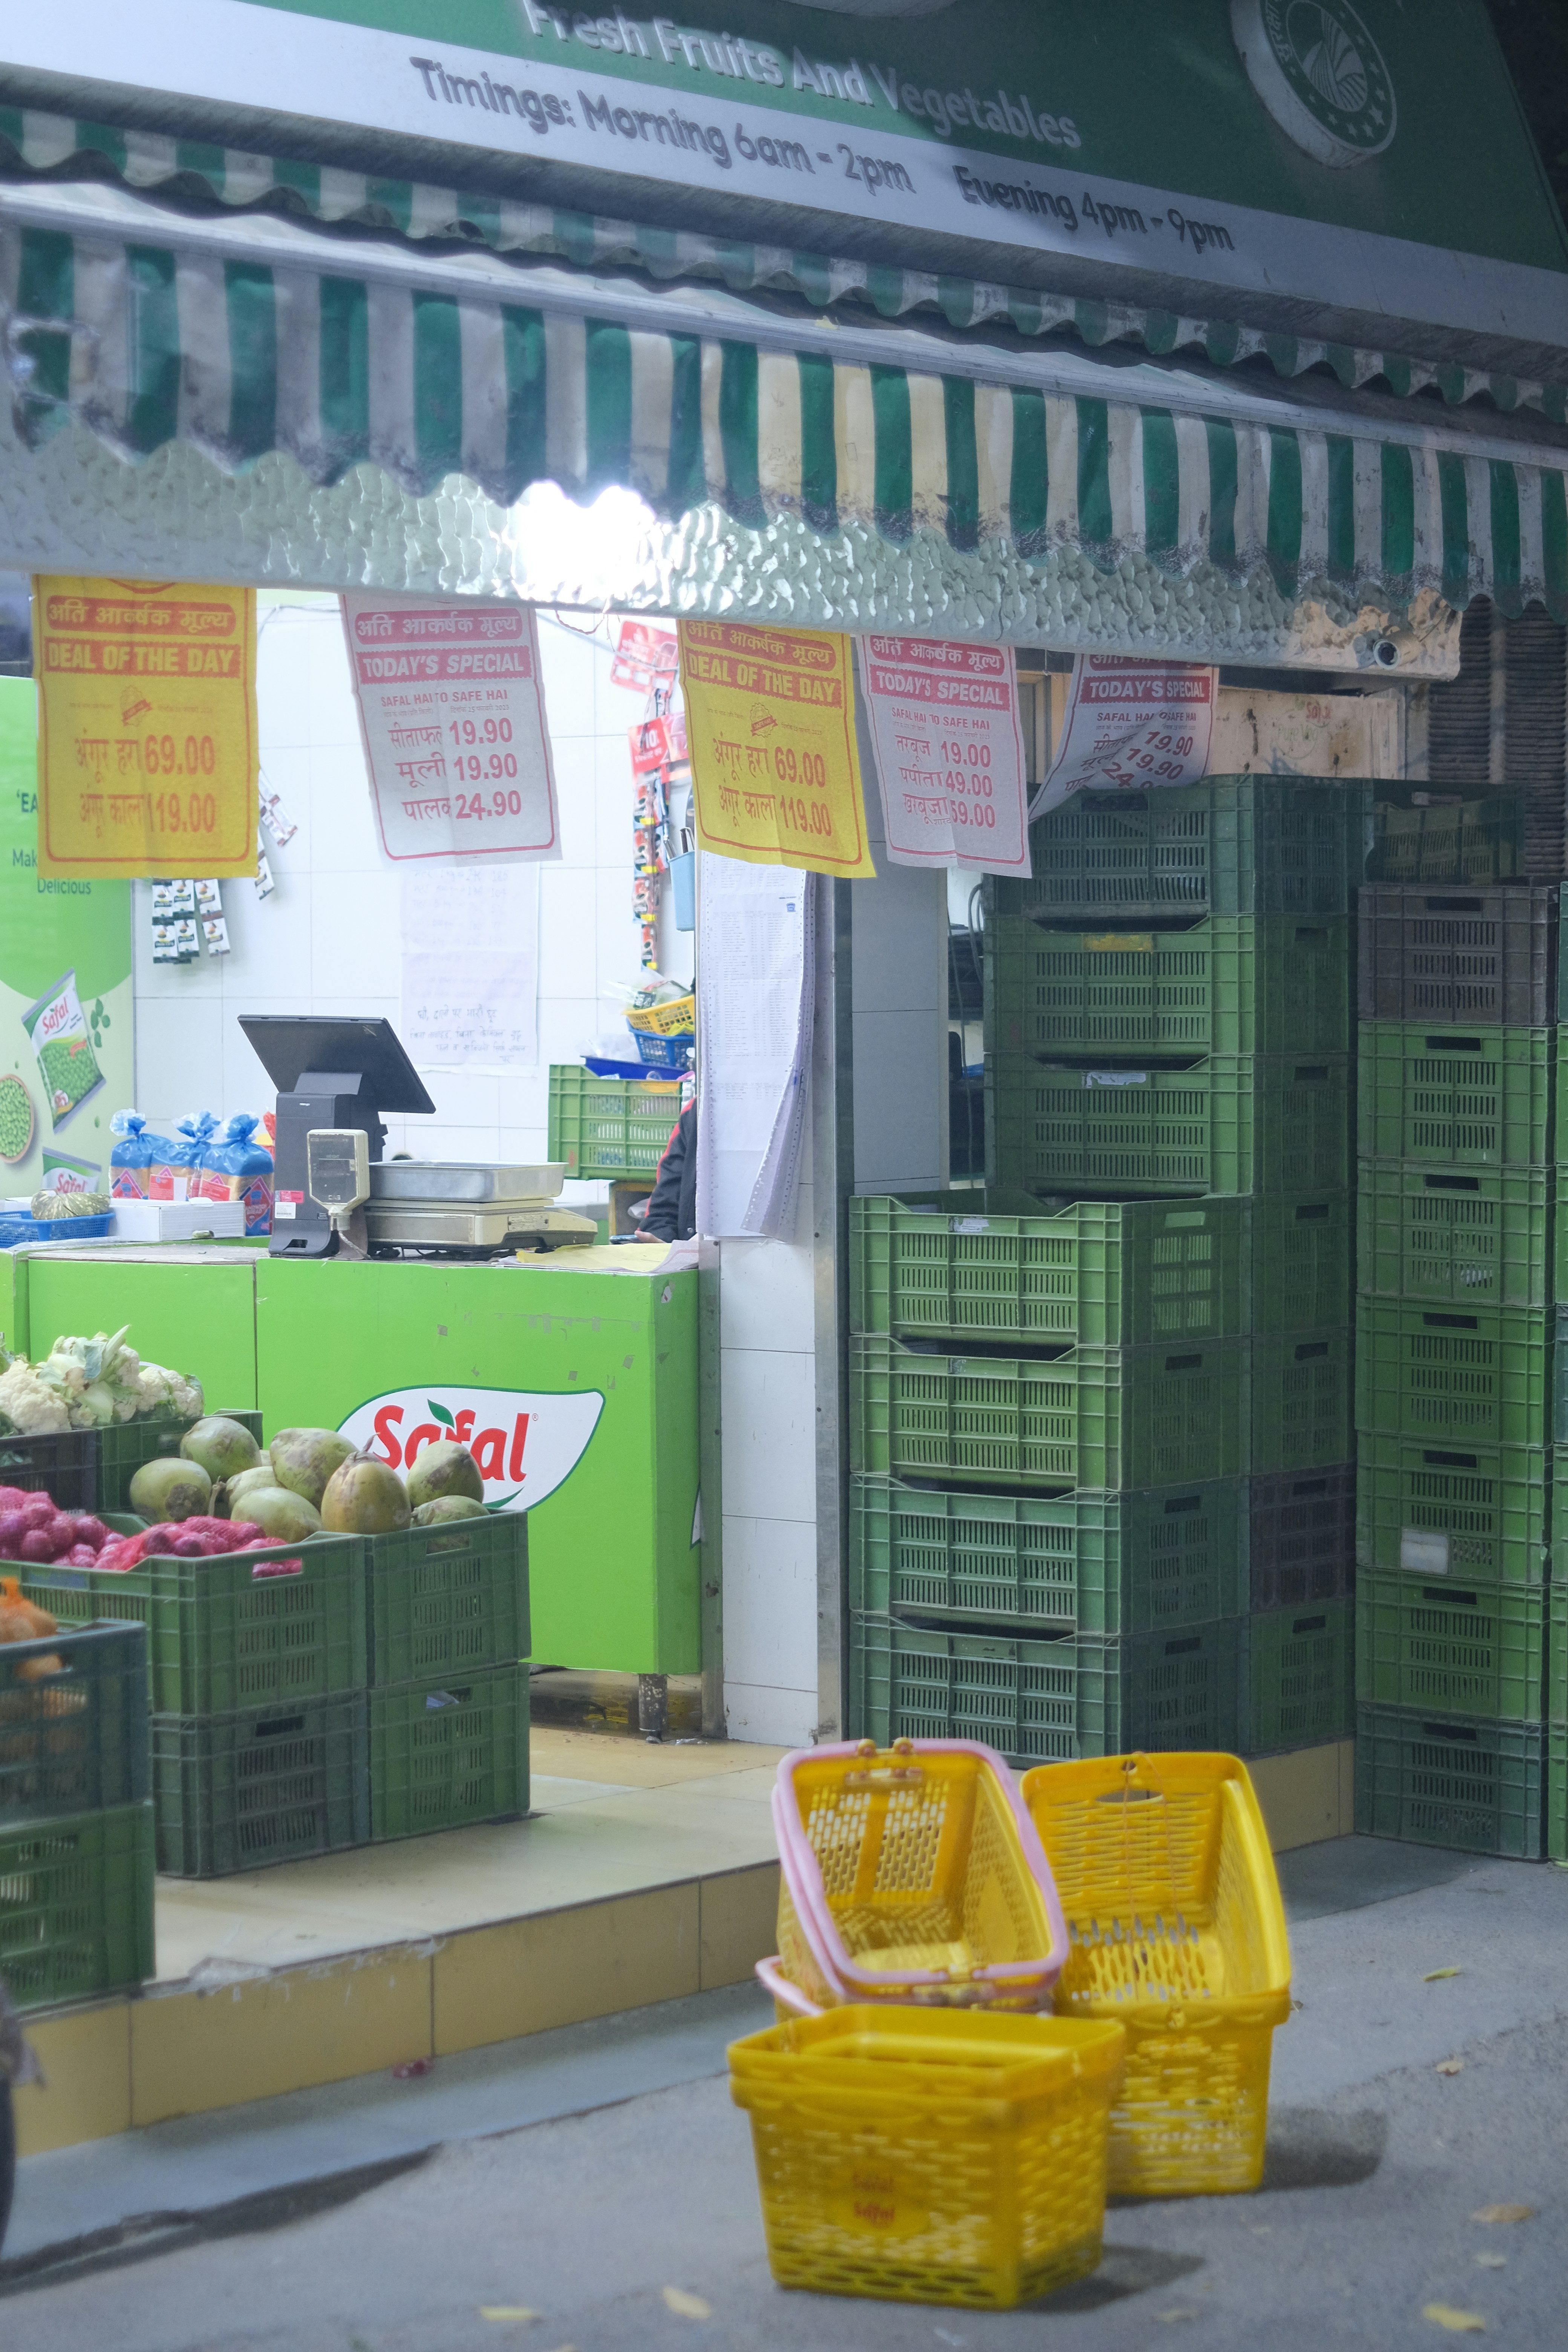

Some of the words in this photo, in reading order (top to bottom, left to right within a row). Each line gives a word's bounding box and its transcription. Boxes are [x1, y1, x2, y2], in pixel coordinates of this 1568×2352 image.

[523, 0, 652, 60] Fresh
[654, 16, 784, 89] Fruits
[792, 45, 877, 108] And
[870, 59, 1081, 148] Vegetables
[410, 56, 575, 135] Timings:
[577, 89, 733, 168] Morning
[734, 123, 816, 174] 6am
[838, 142, 916, 195] 2pm
[953, 165, 1079, 230] Evening
[1081, 193, 1147, 237] 4pm
[1170, 208, 1235, 254] 9pm
[358, 614, 395, 637] अति
[403, 611, 473, 635] आकर्षक
[478, 616, 519, 638] मूल्य
[48, 642, 96, 670] DEAL
[103, 646, 130, 671] OF
[134, 647, 179, 671] THE
[189, 648, 234, 673] DAY
[730, 630, 786, 655] आकर्षक
[791, 644, 832, 665] मूल्य
[911, 643, 962, 663] आकर्षक
[967, 651, 1001, 671] मूल्य
[363, 655, 439, 677] TODAY'S
[447, 653, 524, 674] SPECIAL
[689, 654, 732, 683] DEAL
[736, 665, 758, 687] OF
[763, 669, 793, 697] THE
[799, 677, 836, 702] DAY
[381, 695, 411, 707] SAFAL
[415, 693, 433, 704] HAI
[452, 691, 481, 703] SAFE
[487, 689, 508, 700] HAI
[876, 672, 931, 697] TODAY'S
[937, 681, 1003, 705] SPECIAL
[1090, 681, 1164, 698] TODAY'S
[1167, 681, 1204, 698] SPECIAL
[449, 717, 513, 746] 19.90
[891, 707, 913, 720] SAFAL
[914, 712, 926, 723] HAI
[943, 718, 968, 728] SAFE
[972, 720, 990, 730] HAI
[1097, 712, 1131, 721] SAFAL
[1185, 712, 1196, 721] HAI
[145, 734, 215, 775] 69.00
[941, 740, 991, 768] 19.00
[1144, 731, 1193, 757] 19.90
[395, 751, 446, 788] मूली
[453, 753, 518, 781] 19.90
[775, 746, 826, 788] 69.00
[1126, 748, 1184, 780] 19.90
[945, 770, 992, 797] 49.00
[455, 790, 521, 821] 24.90
[780, 795, 832, 837] 119.00
[950, 799, 995, 828] 59.00
[38, 878, 92, 895] Delicious
[42, 996, 69, 1035] Safal
